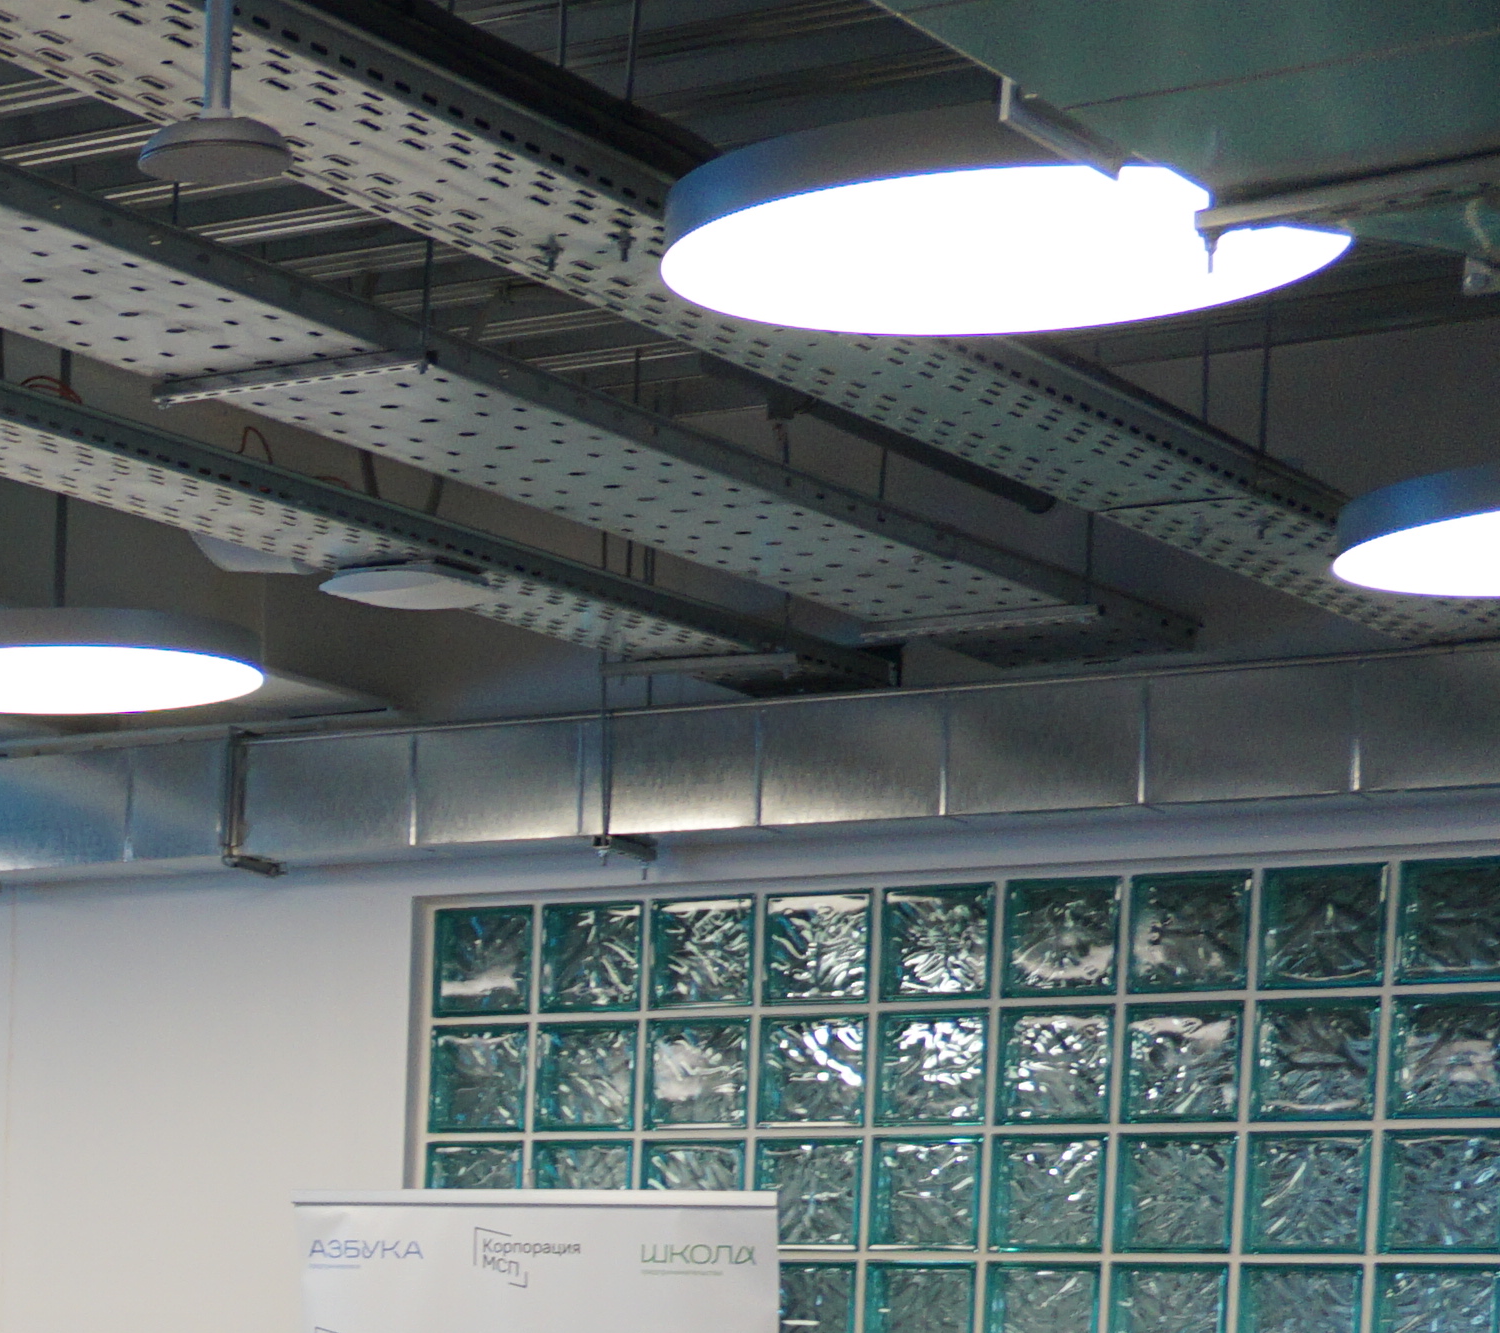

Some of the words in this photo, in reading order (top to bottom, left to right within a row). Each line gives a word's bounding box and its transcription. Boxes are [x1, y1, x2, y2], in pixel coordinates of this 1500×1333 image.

[308, 1239, 424, 1260] АЗБУКА
[482, 1238, 581, 1257] Корпорация
[640, 1242, 757, 1266] ШКОЛА
[482, 1256, 520, 1277] МСП
